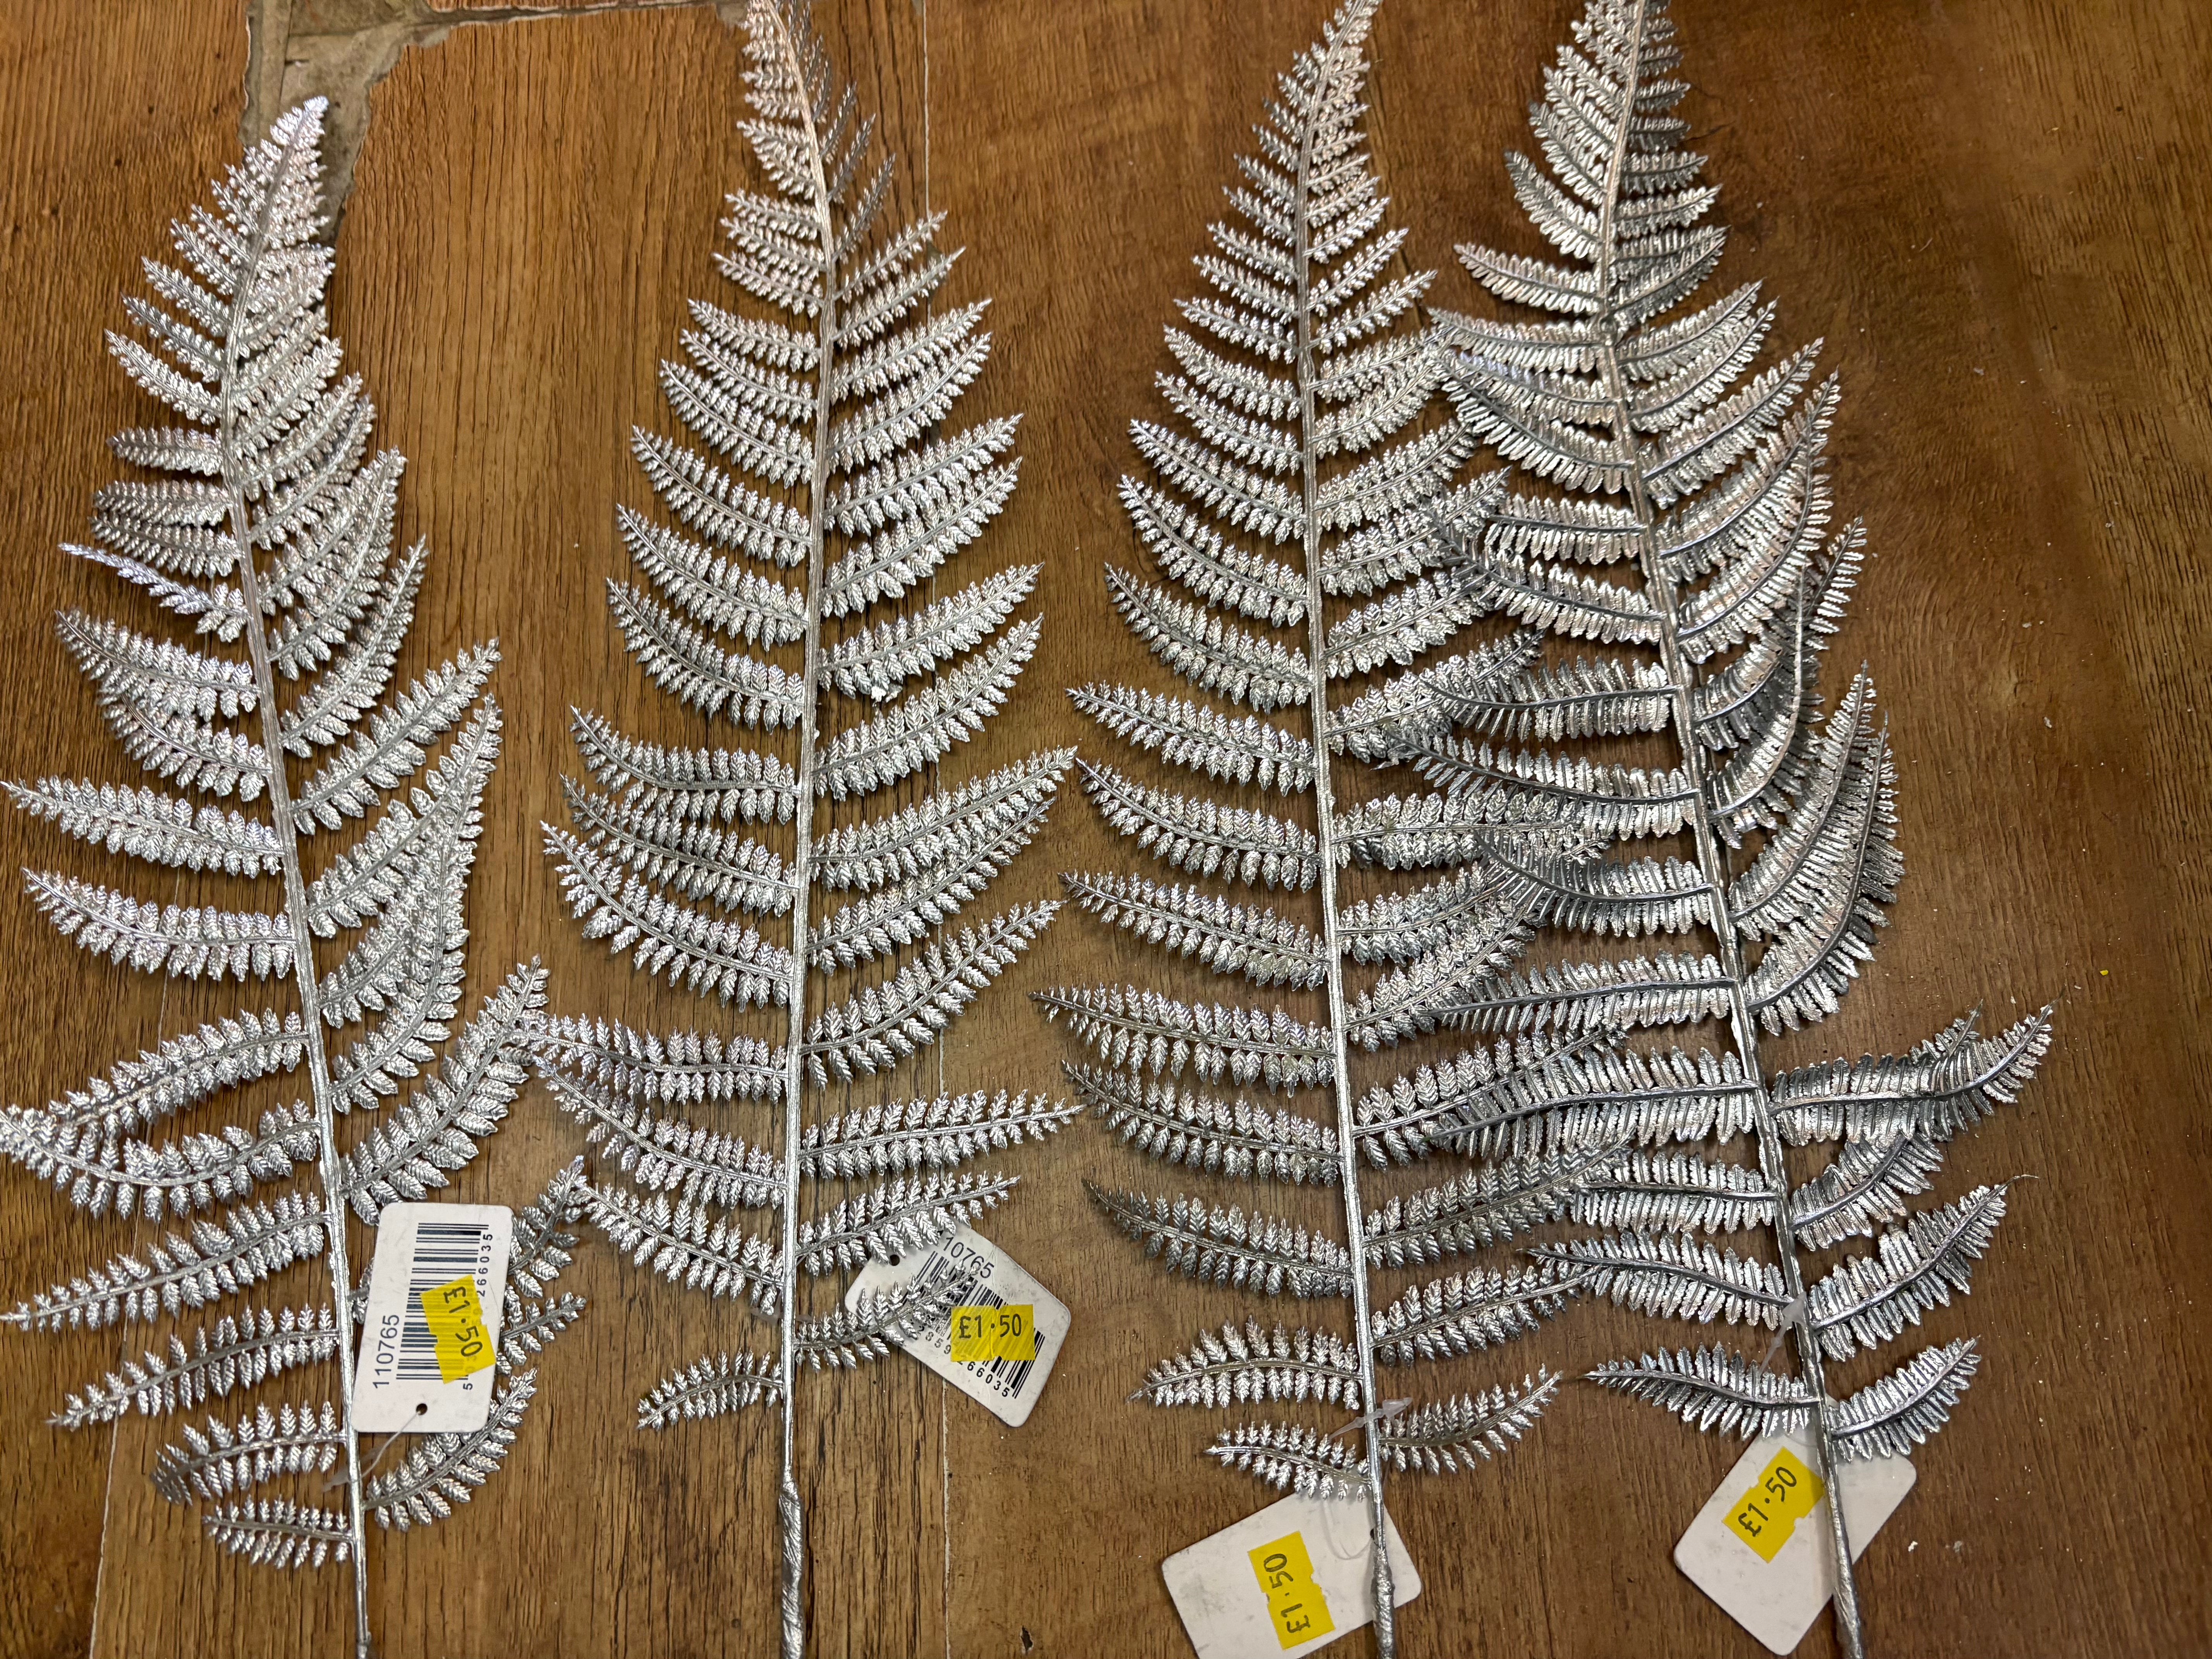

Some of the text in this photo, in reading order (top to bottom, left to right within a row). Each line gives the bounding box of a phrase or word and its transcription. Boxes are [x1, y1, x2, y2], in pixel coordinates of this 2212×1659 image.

[943, 1237, 994, 1278] 10765
[373, 1314, 400, 1388] 110765
[917, 1325, 951, 1354] 2859
